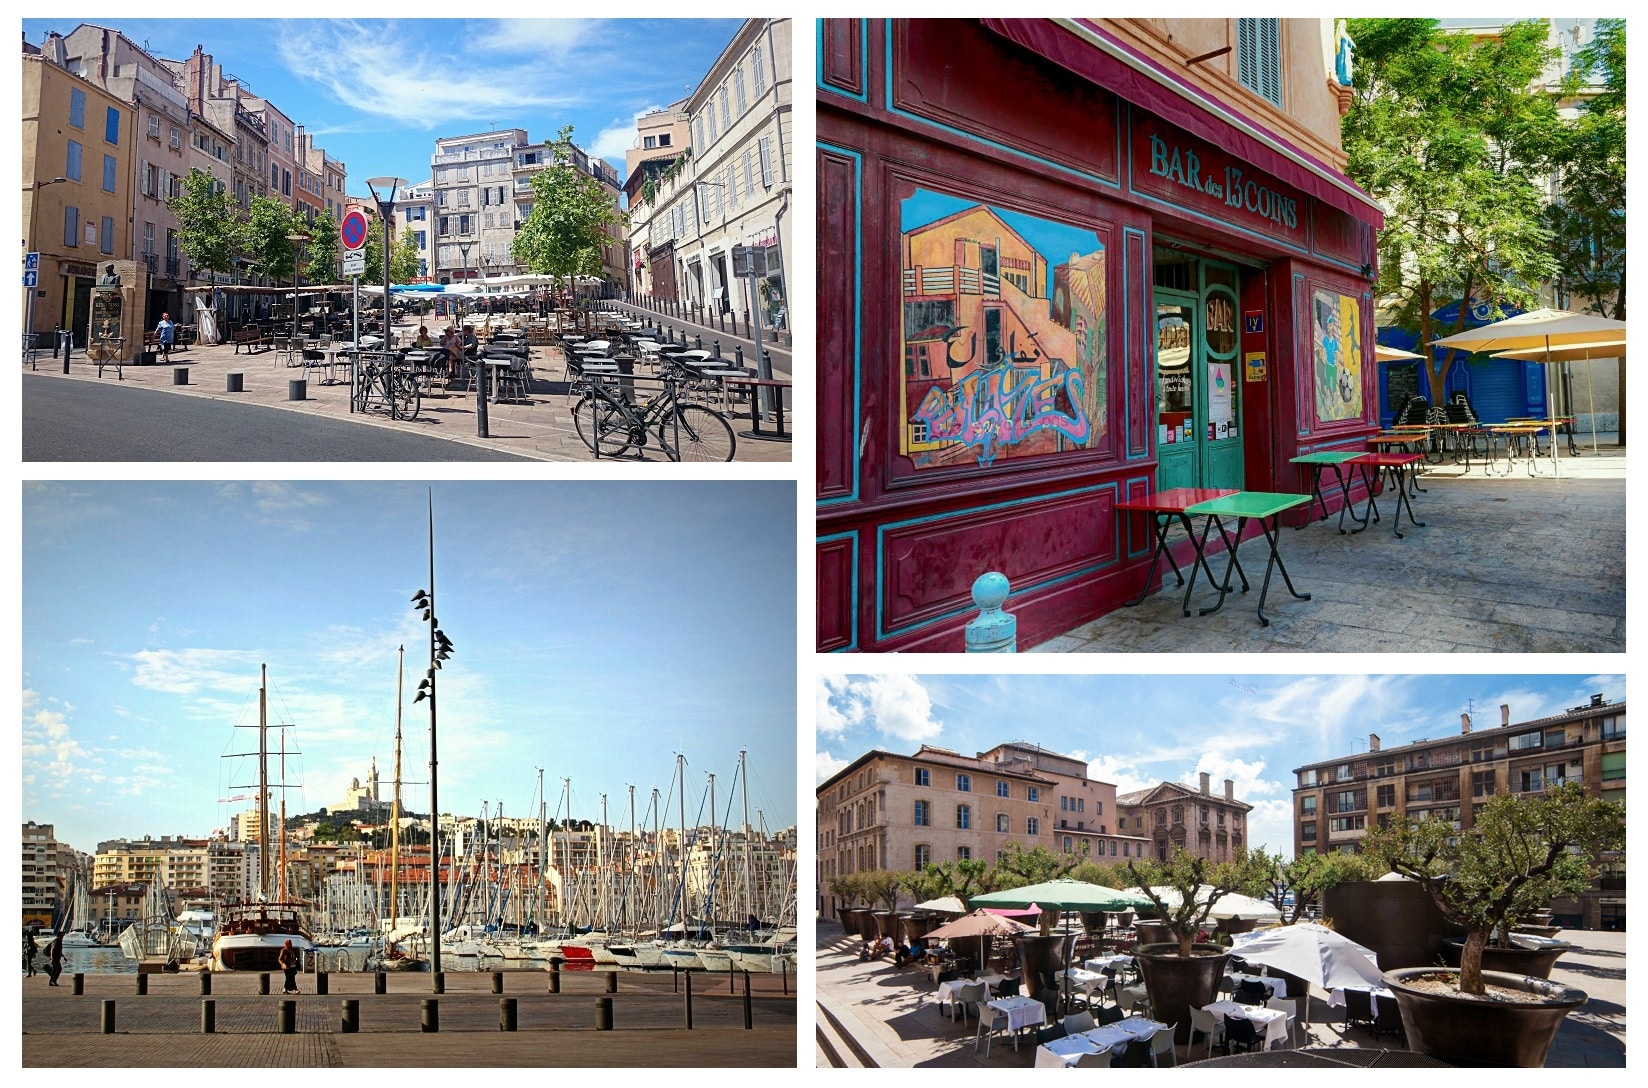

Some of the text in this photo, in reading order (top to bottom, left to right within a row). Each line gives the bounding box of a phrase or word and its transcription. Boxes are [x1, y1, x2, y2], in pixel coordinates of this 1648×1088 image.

[1149, 133, 1298, 229] BAR des 13 COINS
[1206, 299, 1235, 333] BAR
